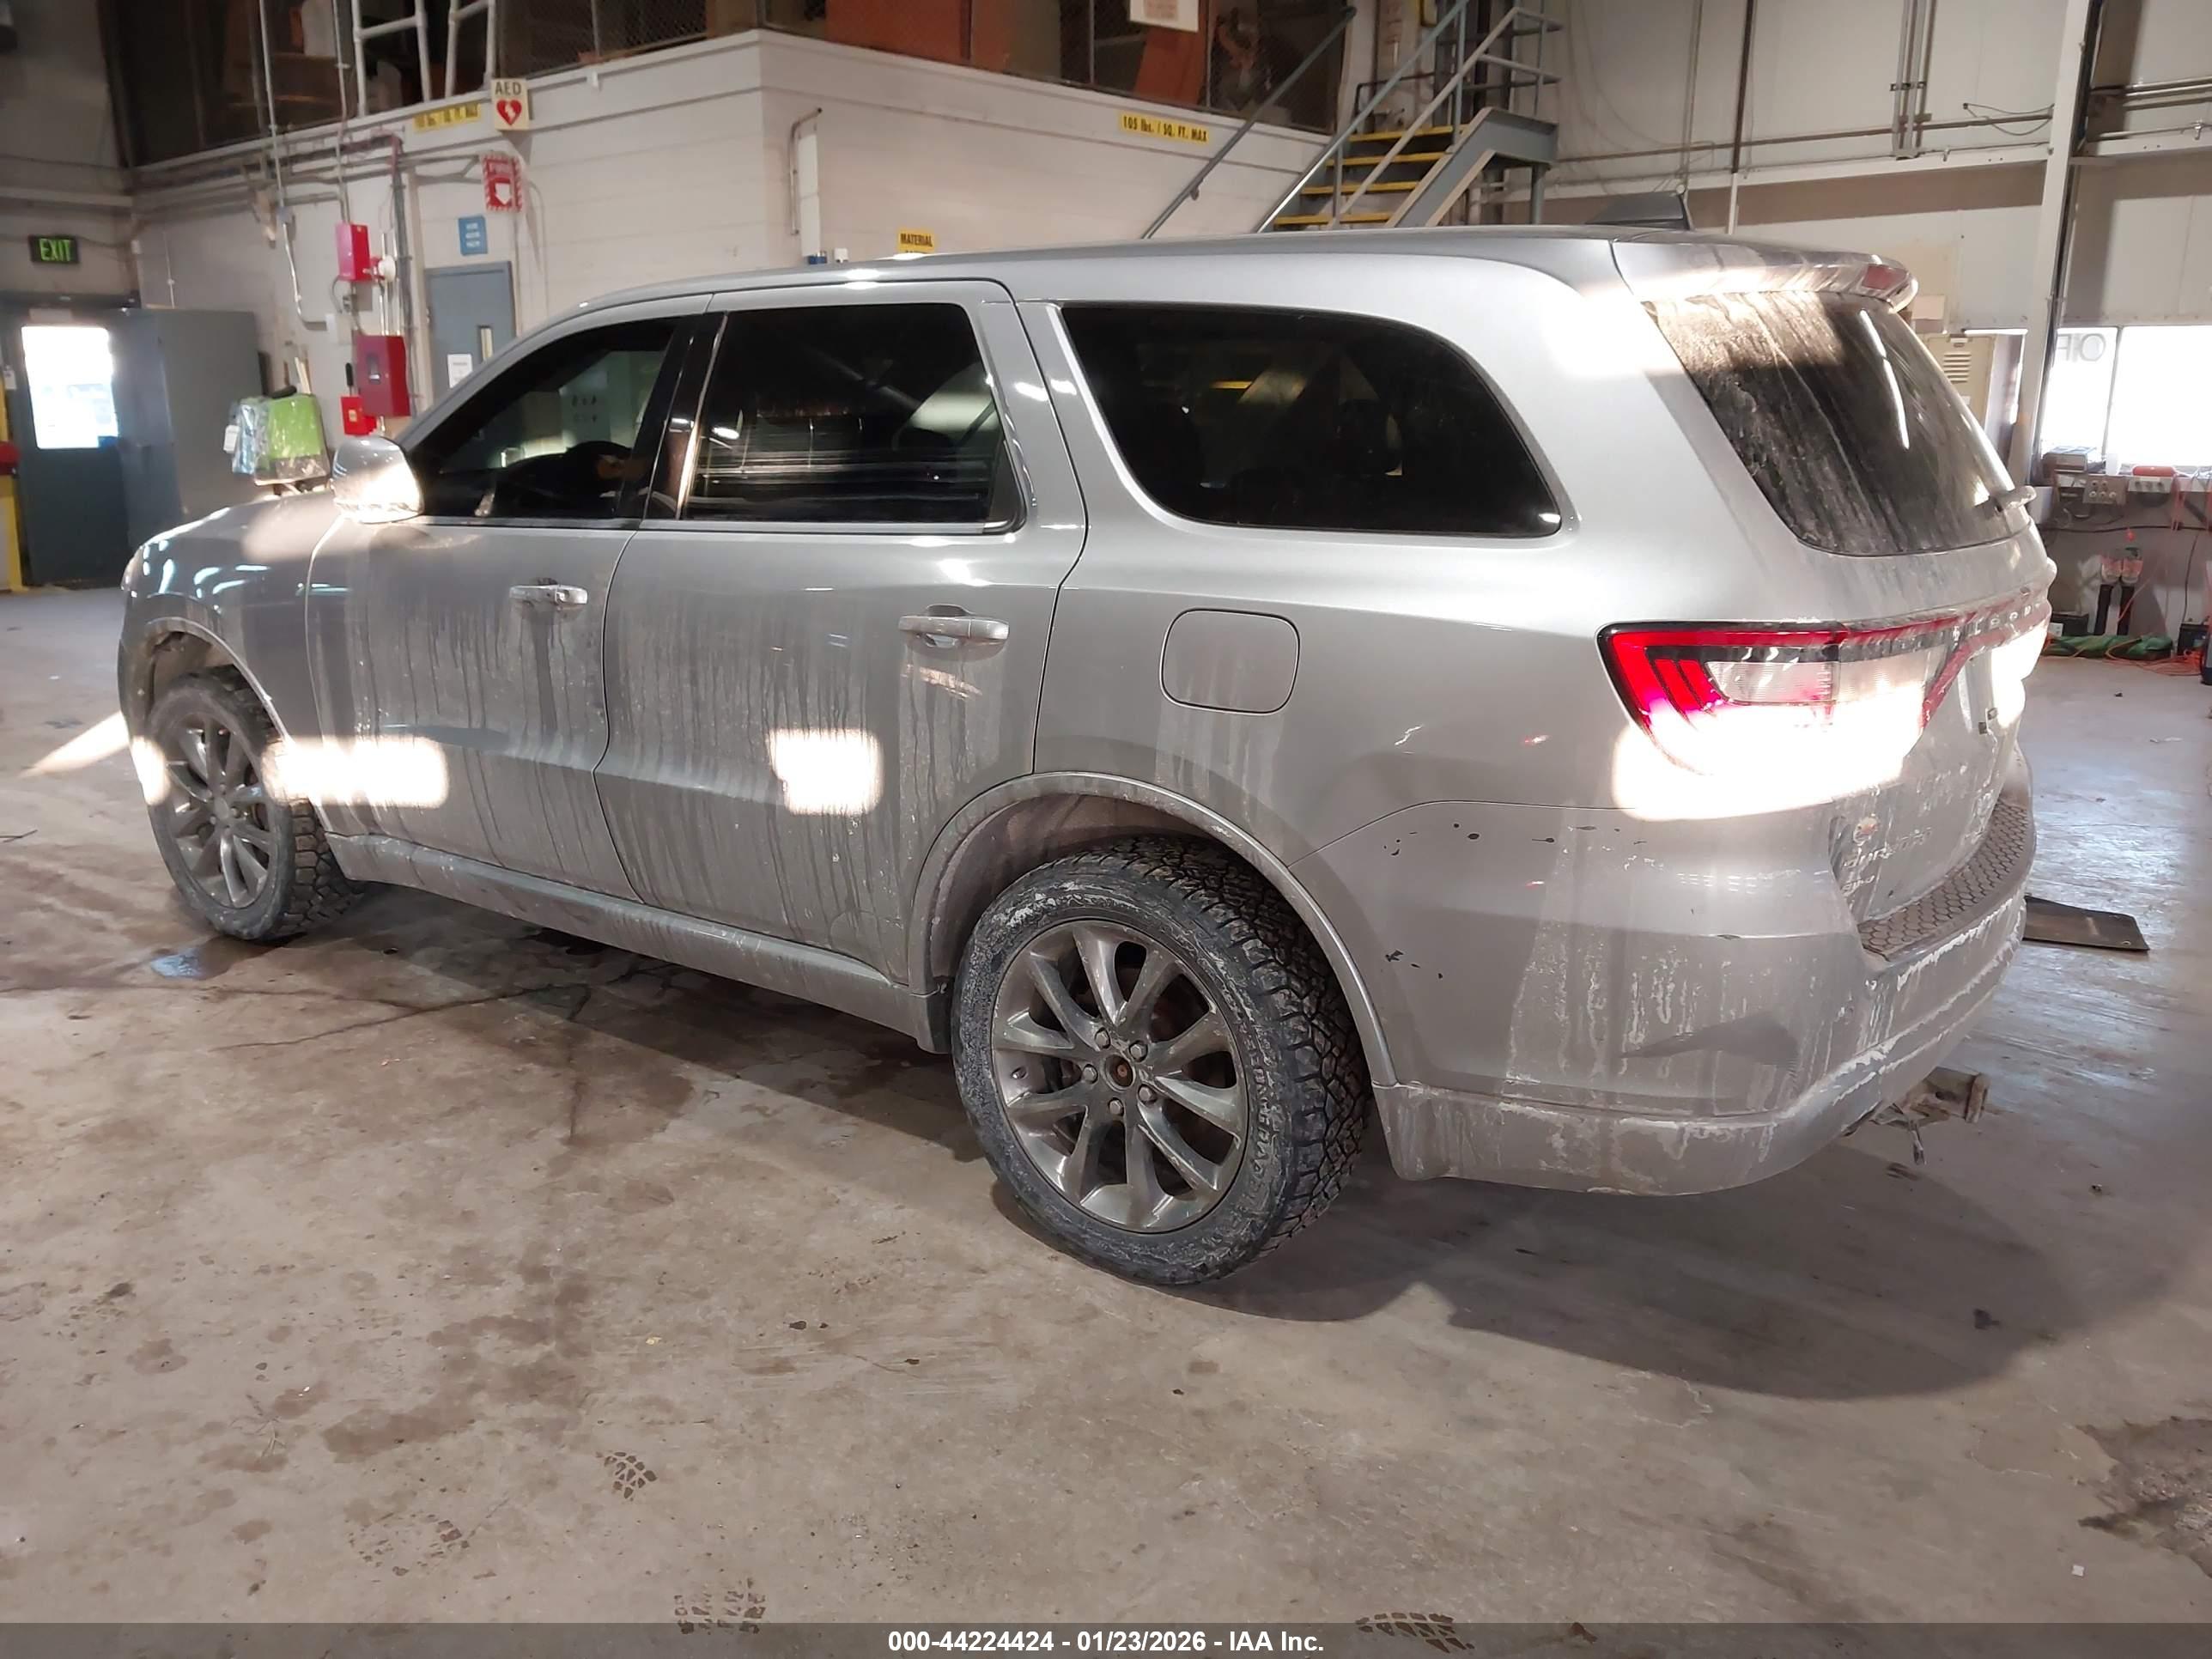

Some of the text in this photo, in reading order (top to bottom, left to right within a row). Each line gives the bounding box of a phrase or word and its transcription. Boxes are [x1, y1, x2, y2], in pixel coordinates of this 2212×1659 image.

[495, 82, 522, 95] AED
[1123, 116, 1138, 131] 105
[1140, 118, 1154, 133] lbs.
[1164, 123, 1176, 137] SQ.
[1178, 125, 1188, 139] FT.
[1191, 128, 1207, 142] MAX
[900, 233, 933, 247] MATERIAL
[40, 239, 70, 261] EXIT
